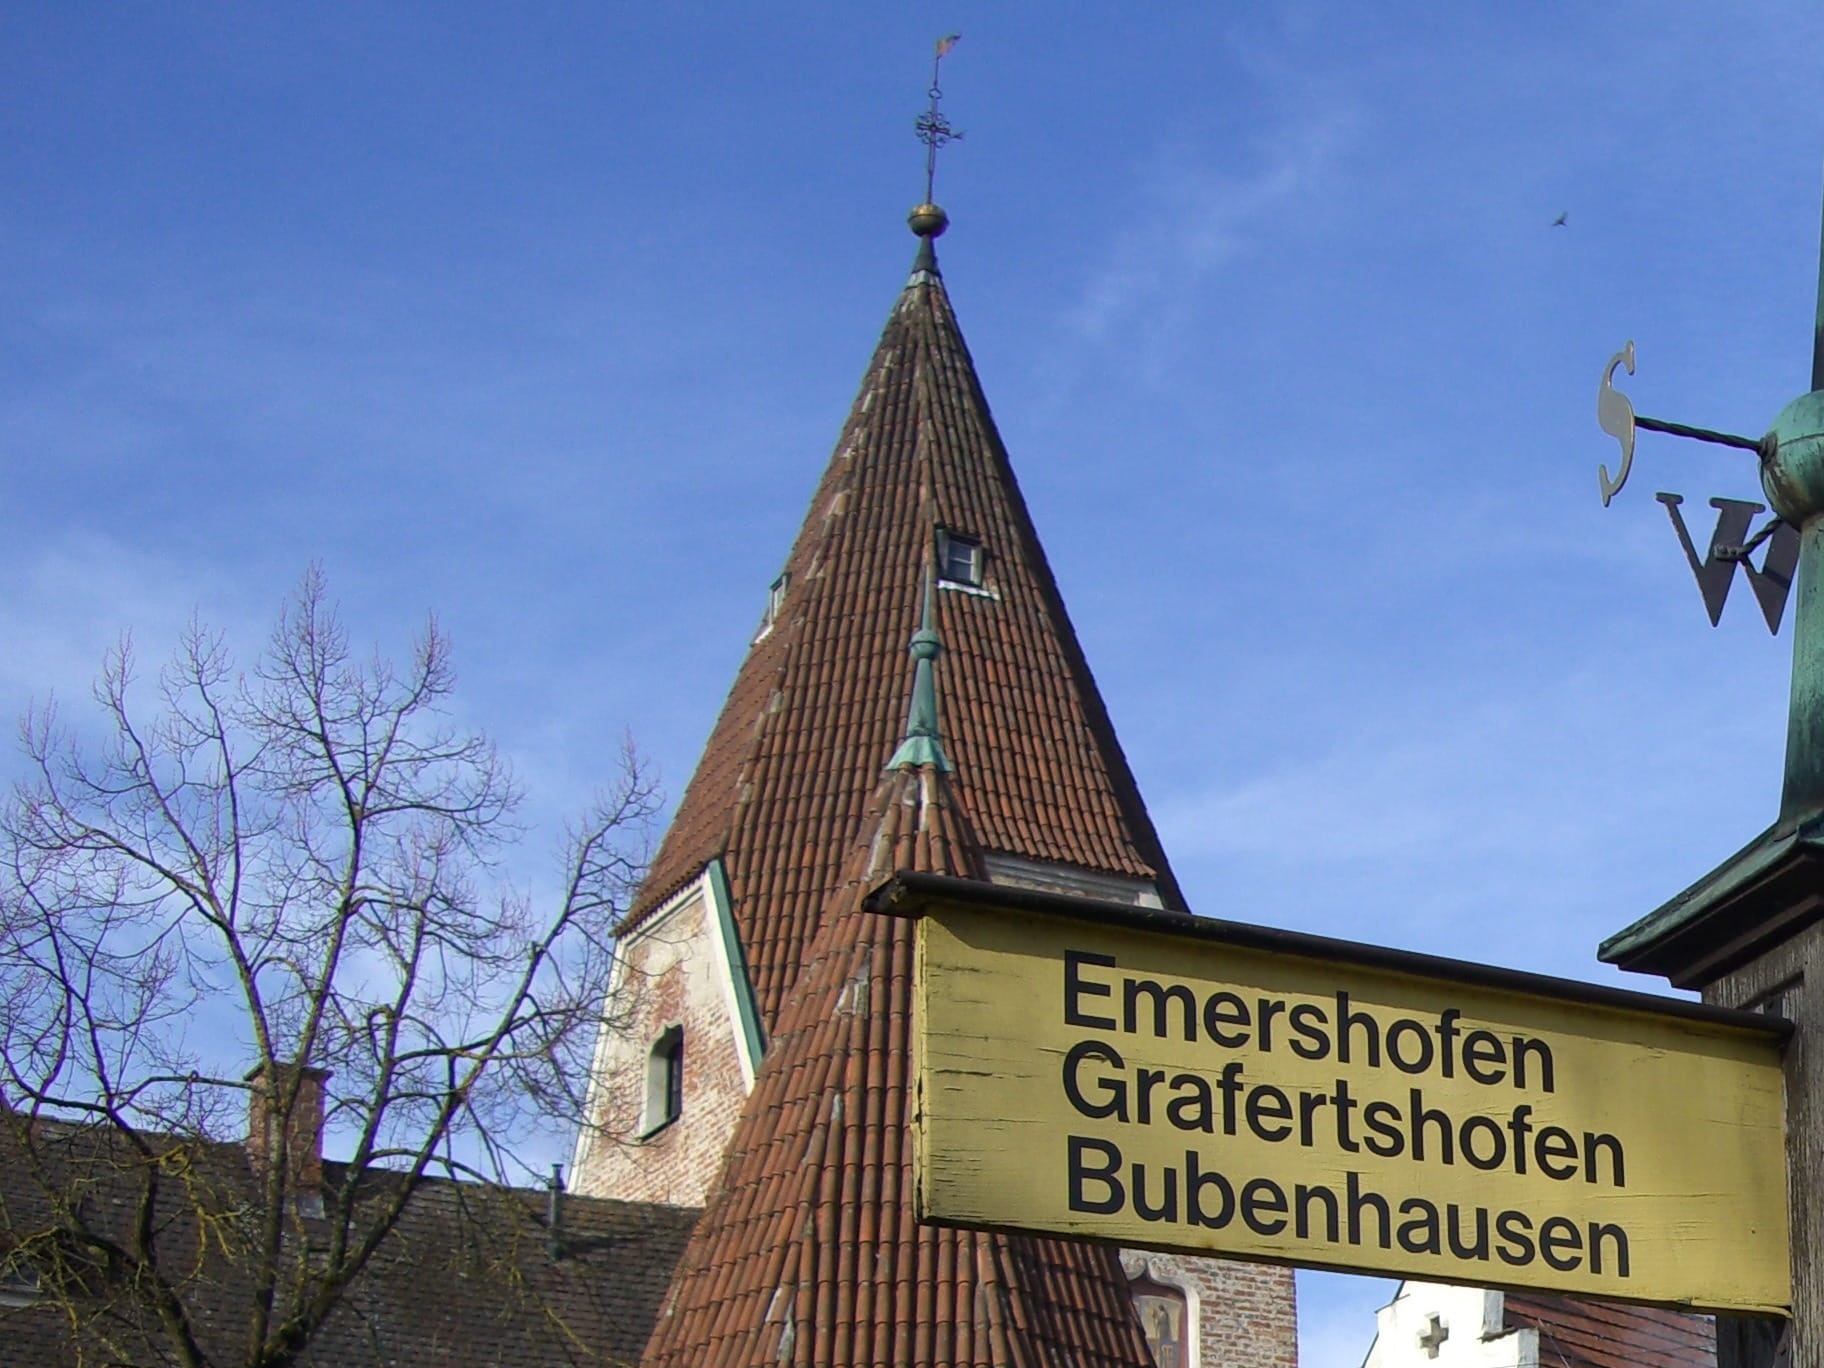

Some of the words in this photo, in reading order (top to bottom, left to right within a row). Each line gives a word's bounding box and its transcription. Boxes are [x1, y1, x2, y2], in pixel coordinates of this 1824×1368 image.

[1063, 949, 1555, 1093] Emershofen
[1062, 1040, 1626, 1188] Grafertshofen
[1068, 1135, 1631, 1278] Bubenhausen
